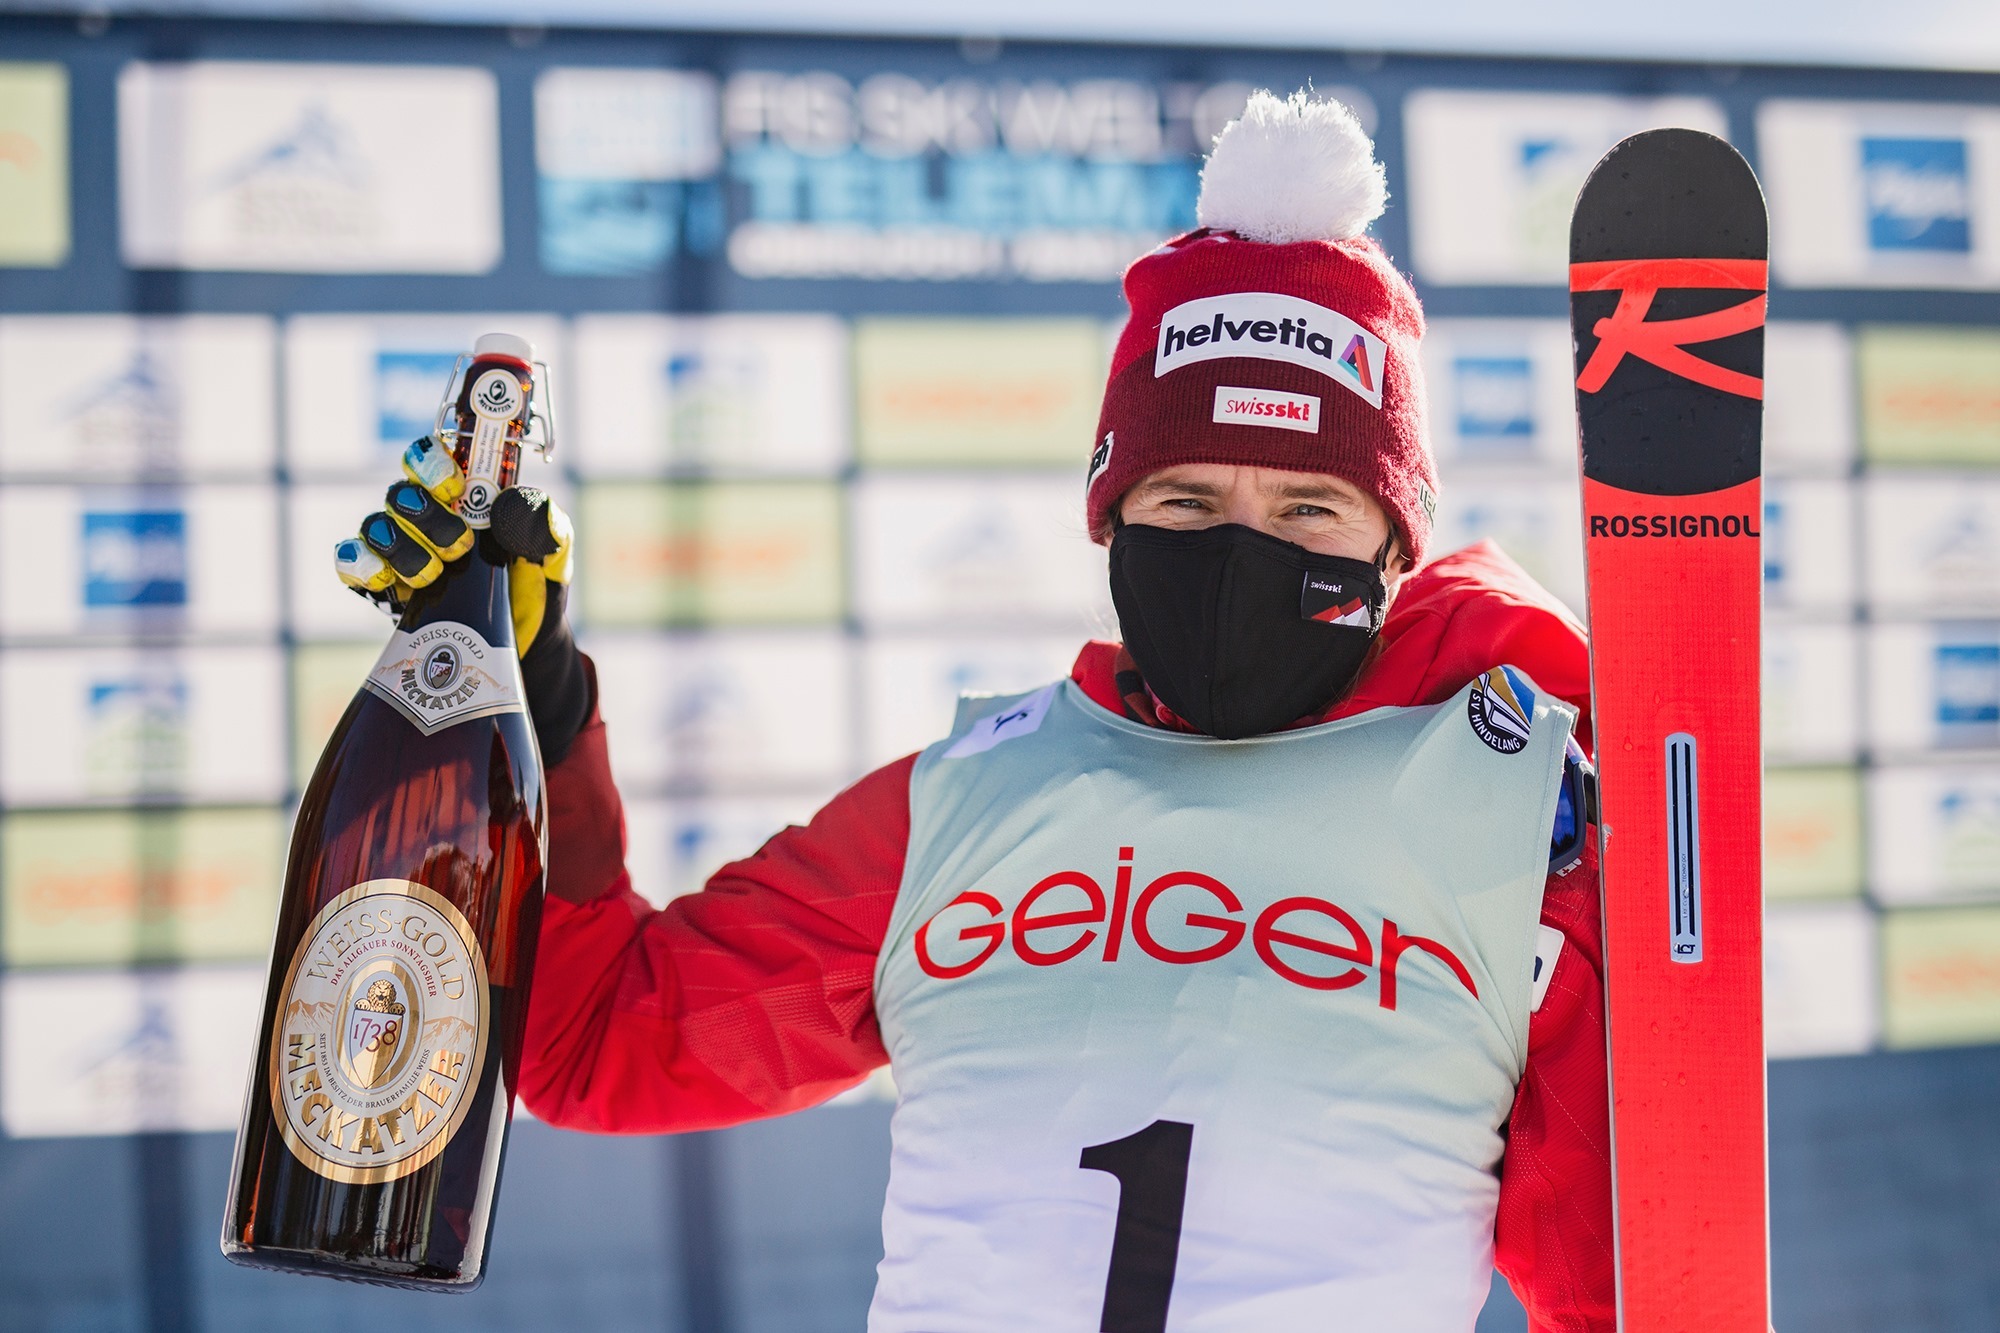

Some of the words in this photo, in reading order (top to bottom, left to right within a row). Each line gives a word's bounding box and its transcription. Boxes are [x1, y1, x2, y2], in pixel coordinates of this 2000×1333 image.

[1163, 313, 1334, 361] helvetia
[1225, 397, 1310, 422] swissski
[459, 505, 490, 520] MECKATZE
[1590, 515, 1760, 538] ROSSIGNOL
[1310, 580, 1343, 594] swissski
[408, 628, 484, 660] WEISS-GOLD
[401, 668, 481, 710] MECKATZER
[431, 664, 452, 678] 1738
[1471, 693, 1481, 710] SV
[1471, 714, 1520, 751] HINDELANG
[306, 909, 466, 1000] WEISS-GOLD
[330, 967, 345, 986] DAS
[343, 939, 388, 969] ALLGÄUER
[390, 939, 438, 998] SONNTAGSBIER
[353, 1017, 398, 1053] 1738
[319, 1032, 327, 1050] SEIT
[323, 1066, 332, 1077] IM
[328, 1077, 348, 1099] BESITZ
[346, 1096, 364, 1108] DER
[365, 1071, 420, 1109] BRAUERFAMILIE
[416, 1048, 431, 1071] WEISS
[288, 1032, 467, 1156] MECKATZER
[1079, 1119, 1195, 1333] 1
